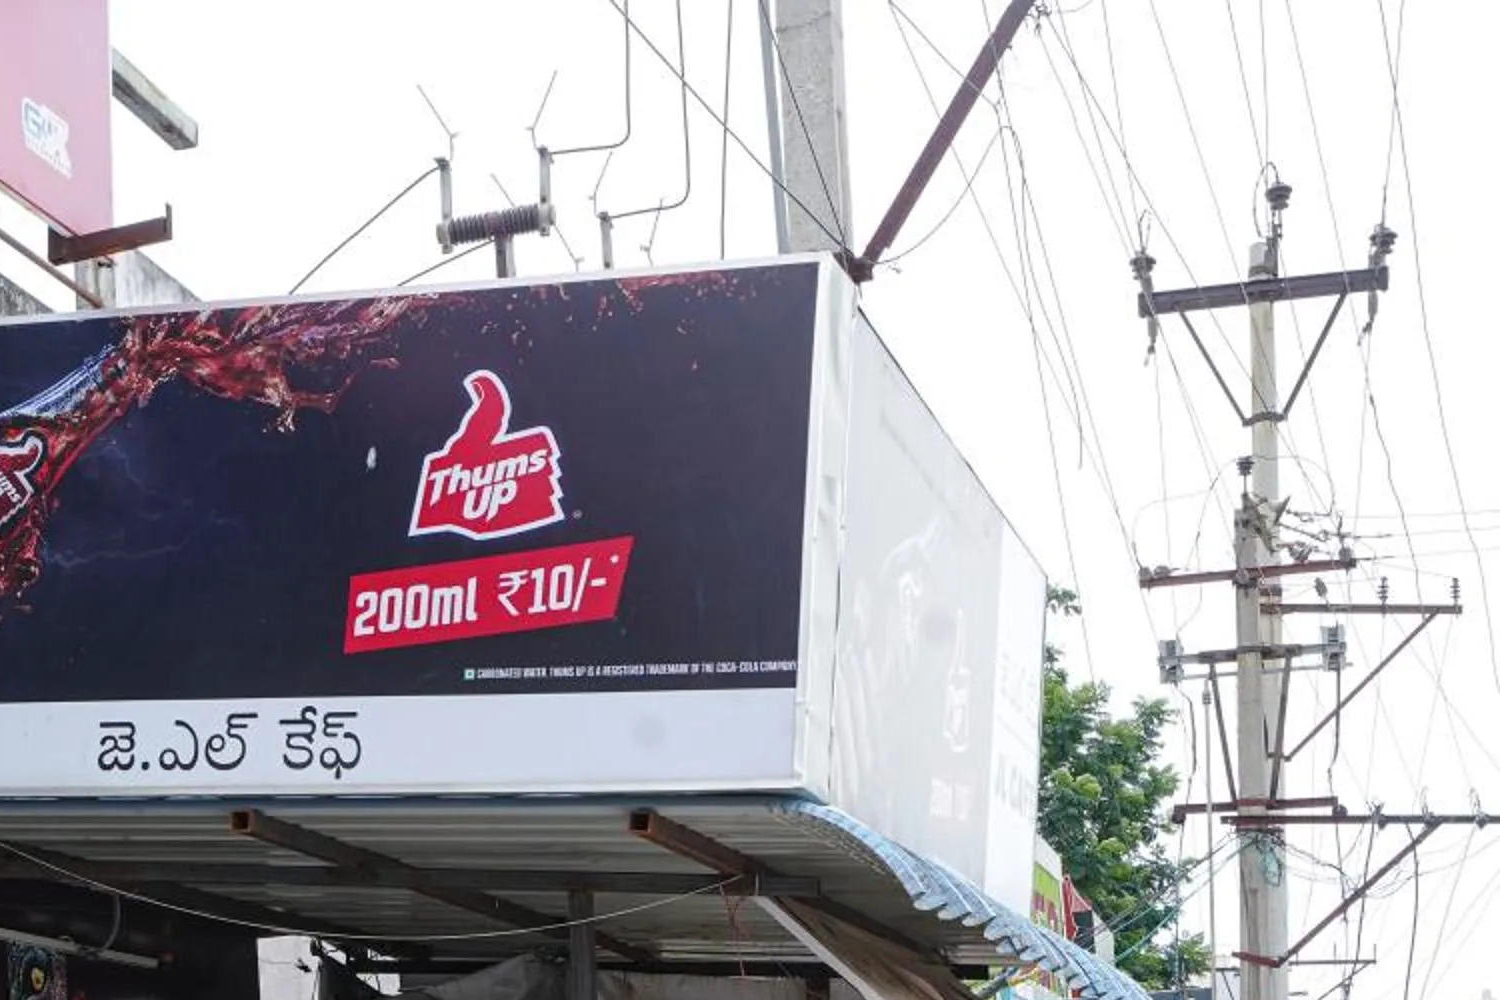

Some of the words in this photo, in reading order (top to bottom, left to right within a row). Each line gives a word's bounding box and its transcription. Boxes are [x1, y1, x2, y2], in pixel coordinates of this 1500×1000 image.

[428, 449, 547, 505] Thums
[353, 577, 477, 638] 200ml
[279, 706, 362, 779] కేఫ్
